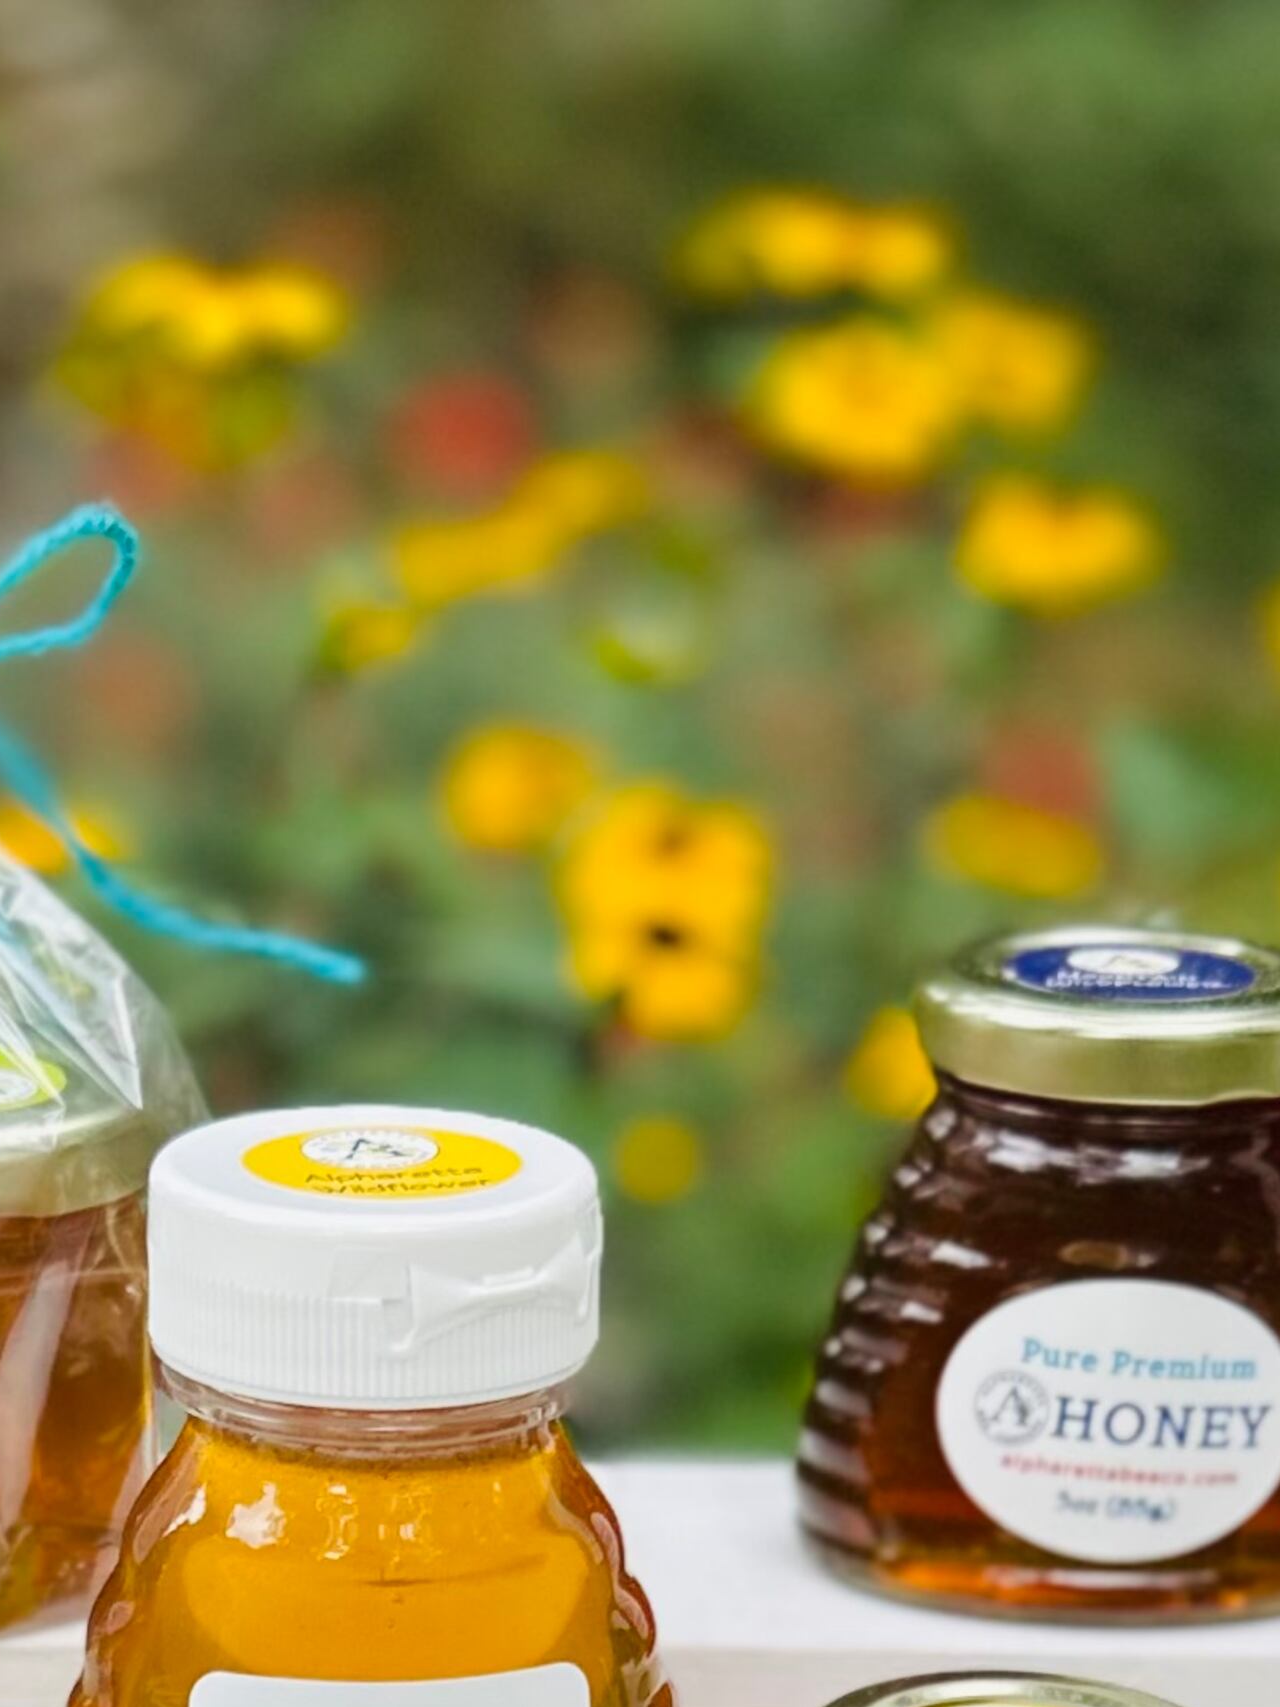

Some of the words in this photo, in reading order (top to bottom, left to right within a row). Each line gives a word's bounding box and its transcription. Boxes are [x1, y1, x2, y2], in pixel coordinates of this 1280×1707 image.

[1021, 1337, 1099, 1372] Pure
[1111, 1351, 1258, 1380] Premium
[1051, 1395, 1272, 1449] HONEY
